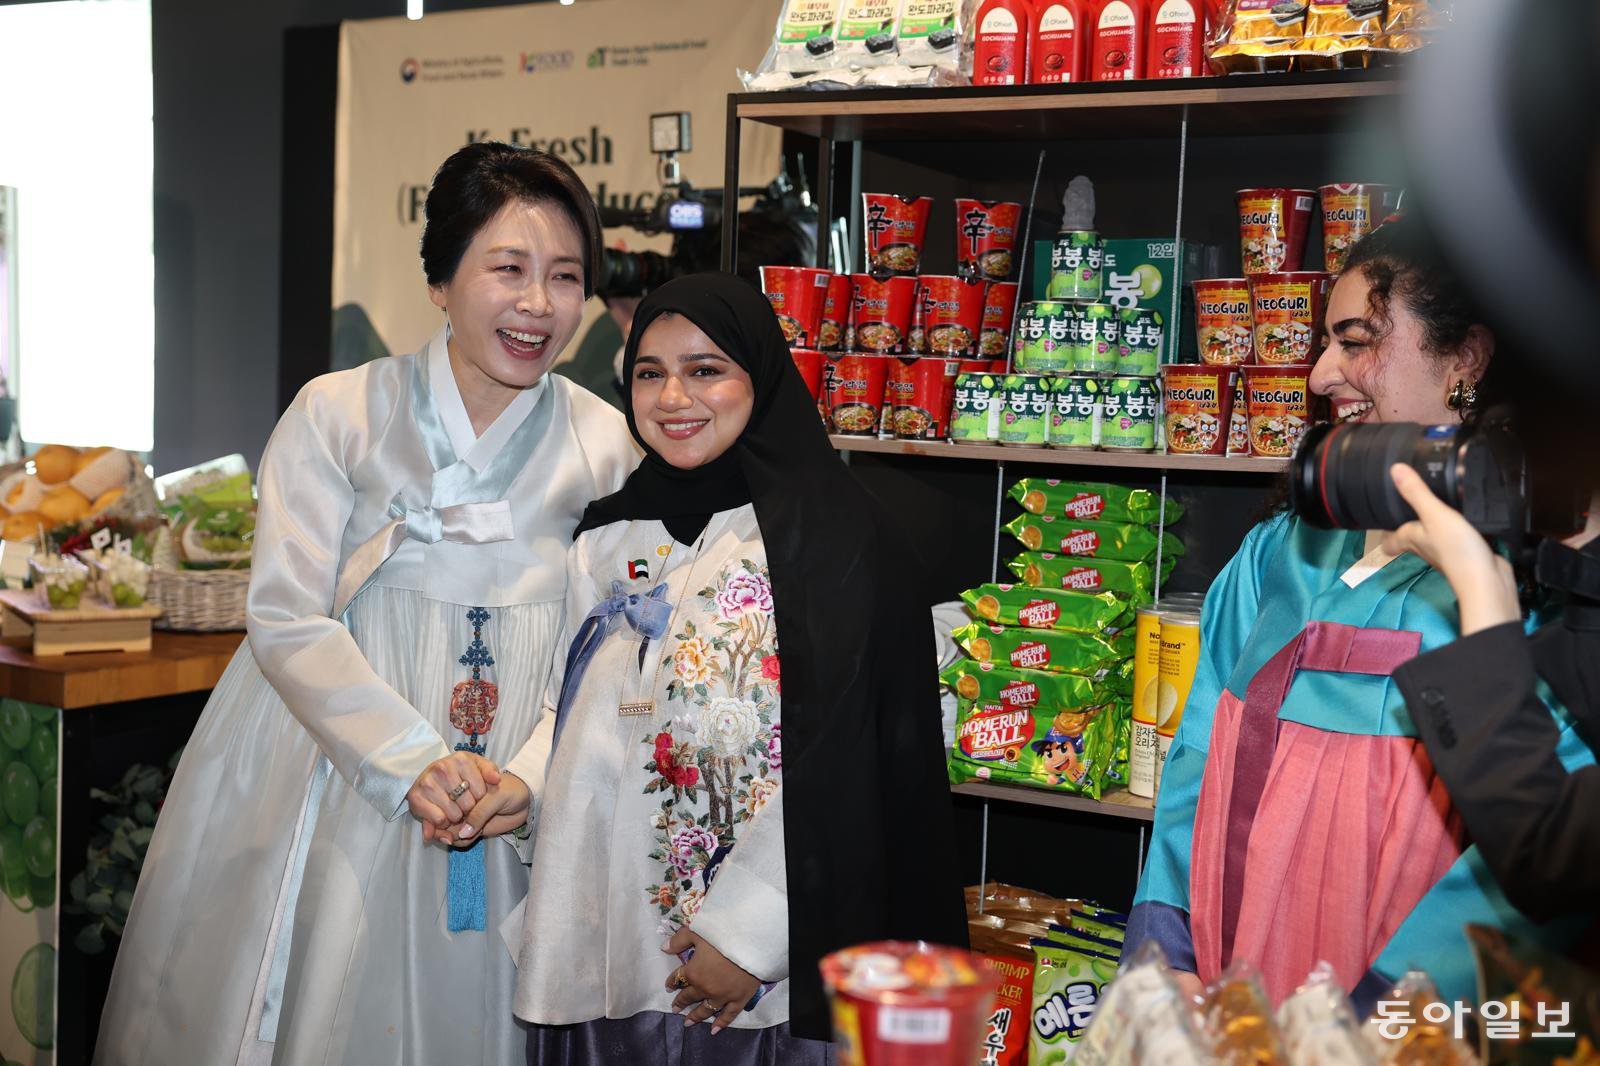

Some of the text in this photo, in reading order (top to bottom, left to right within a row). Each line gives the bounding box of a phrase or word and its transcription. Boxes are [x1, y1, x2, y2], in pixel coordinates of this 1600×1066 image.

[1099, 28, 1135, 37] GOCHUJANG
[1157, 25, 1193, 33] GOCHUJANG
[868, 202, 894, 249] 辛
[1241, 212, 1280, 225] EOGURI
[964, 208, 995, 256] 辛
[1257, 295, 1308, 310] NEOGURI
[1167, 388, 1215, 401] NEOGURI
[1252, 390, 1304, 403] NEOGURI
[1010, 392, 1047, 413] 봉봉
[1056, 393, 1095, 415] 봉봉
[1065, 495, 1101, 512] HOMERUN
[1074, 504, 1100, 518] BALL
[1061, 531, 1096, 547] HOMERUN
[1070, 540, 1096, 554] BALL
[1062, 569, 1098, 585] HOMERUN
[1019, 602, 1056, 619] HOMERUN
[1029, 610, 1056, 625] BALL
[1149, 632, 1160, 640] No
[1010, 644, 1046, 661] HOMERUN
[1021, 653, 1046, 667] BALL
[1000, 684, 1035, 698] HOMERUN
[1010, 692, 1035, 705] BALL
[960, 708, 1029, 736] HOMERUN
[974, 726, 1025, 748] BALL
[984, 958, 1030, 979] SHRIMP
[981, 1007, 1012, 1066] 새우
